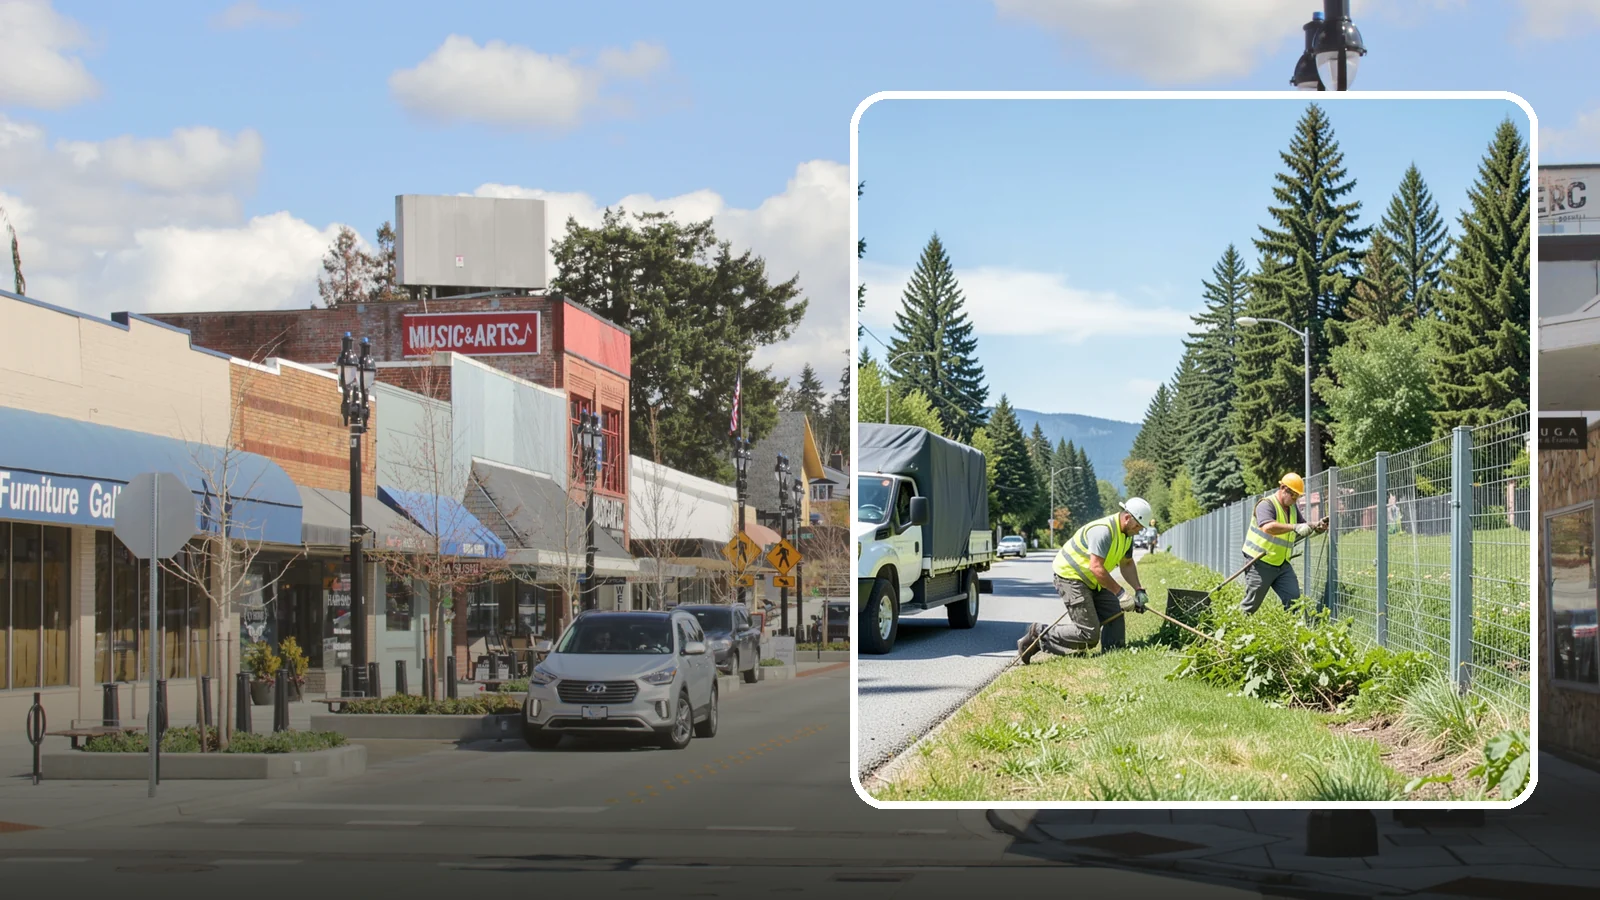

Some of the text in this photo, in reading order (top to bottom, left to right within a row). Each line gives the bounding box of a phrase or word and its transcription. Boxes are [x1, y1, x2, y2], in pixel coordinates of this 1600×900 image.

[408, 323, 520, 349] MUSIC&ARTS
[0, 471, 122, 519] Furniture Gal
